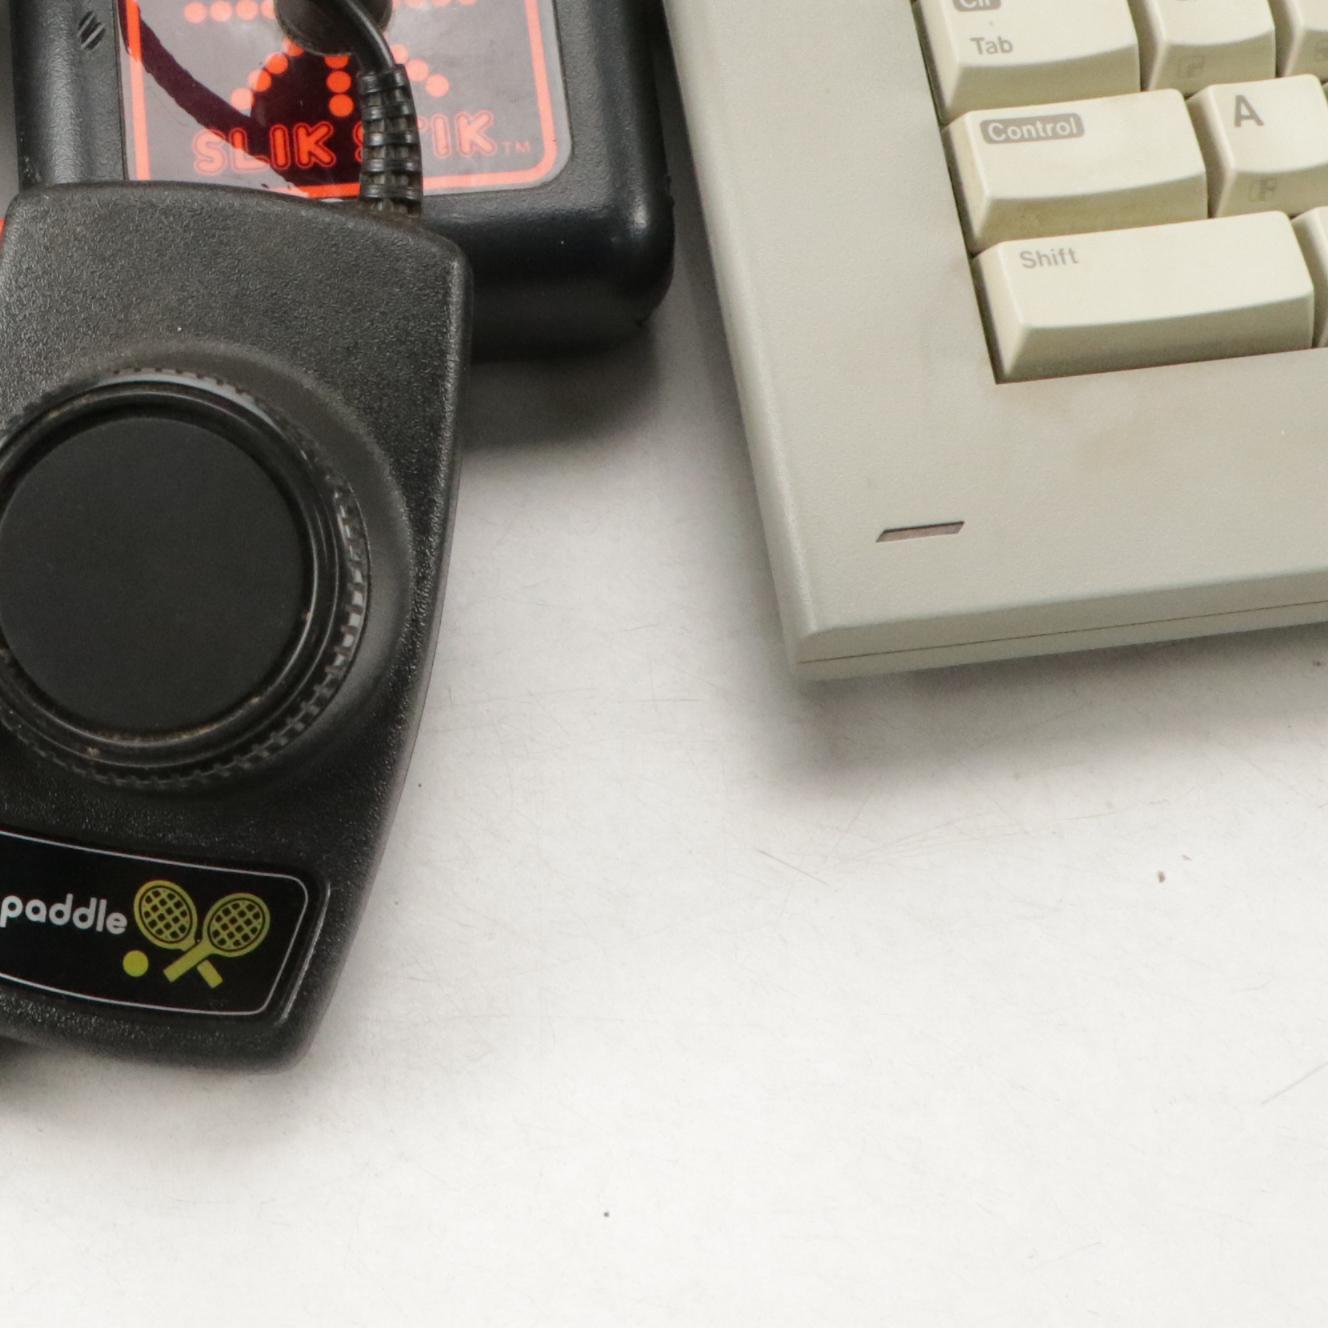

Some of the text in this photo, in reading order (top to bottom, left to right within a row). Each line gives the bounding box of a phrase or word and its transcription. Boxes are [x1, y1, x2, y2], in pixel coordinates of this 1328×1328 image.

[969, 34, 1014, 57] Tab
[1233, 94, 1264, 128] A
[986, 117, 1080, 143] Control
[192, 120, 337, 176] SLIK
[1019, 247, 1079, 270] Shift
[0, 893, 127, 935] paddle
